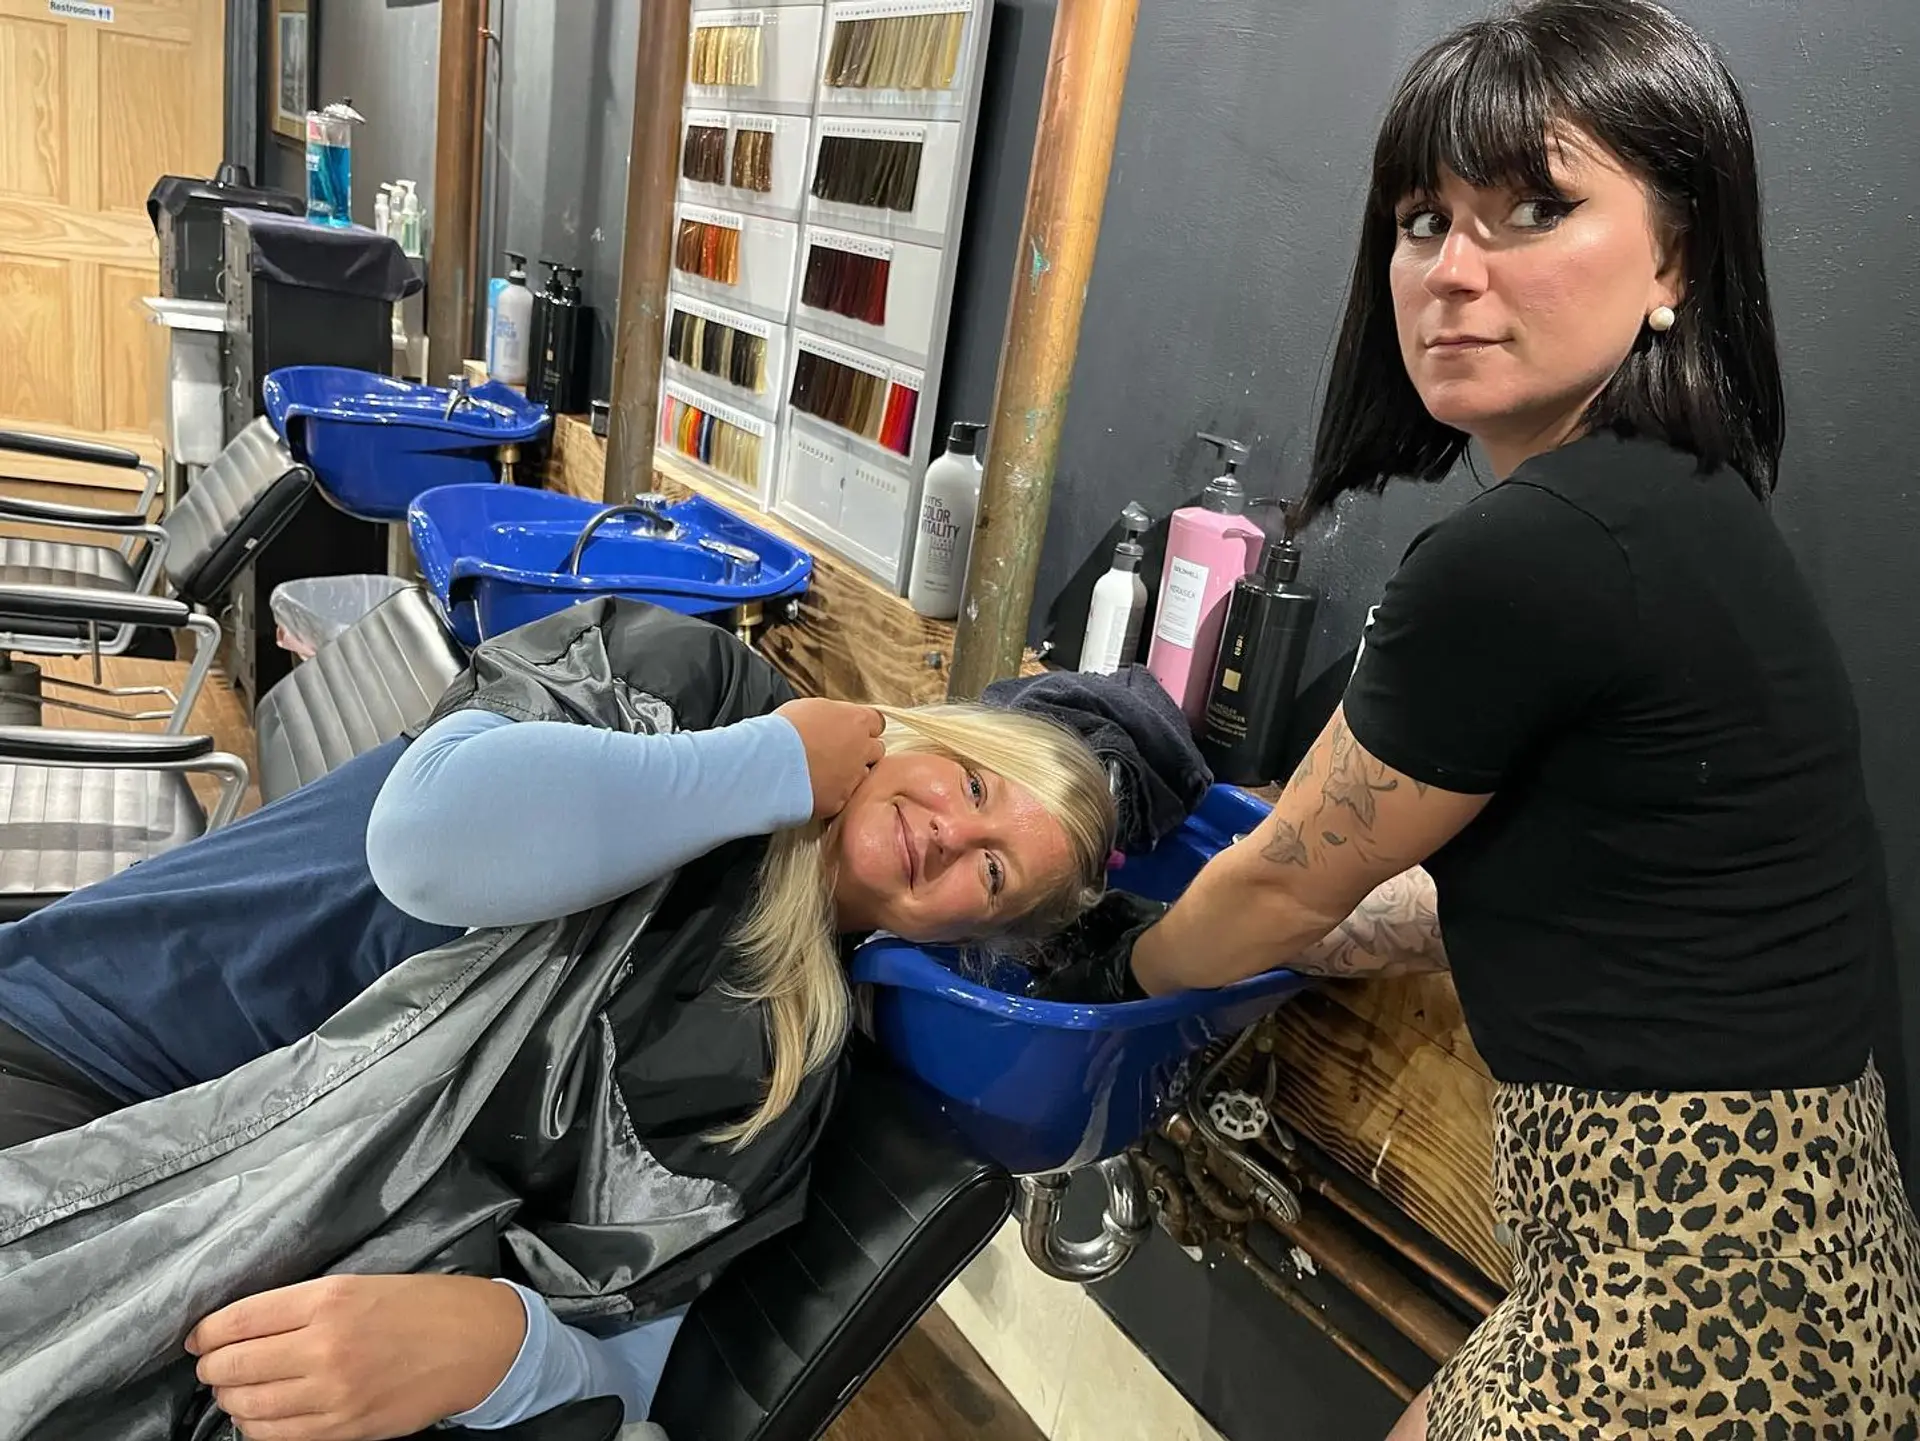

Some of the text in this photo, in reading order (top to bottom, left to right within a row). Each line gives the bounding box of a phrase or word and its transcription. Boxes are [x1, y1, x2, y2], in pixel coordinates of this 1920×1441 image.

[49, 1, 96, 16] Restrooms
[922, 504, 951, 523] COLOR
[921, 519, 961, 539] VITALITY
